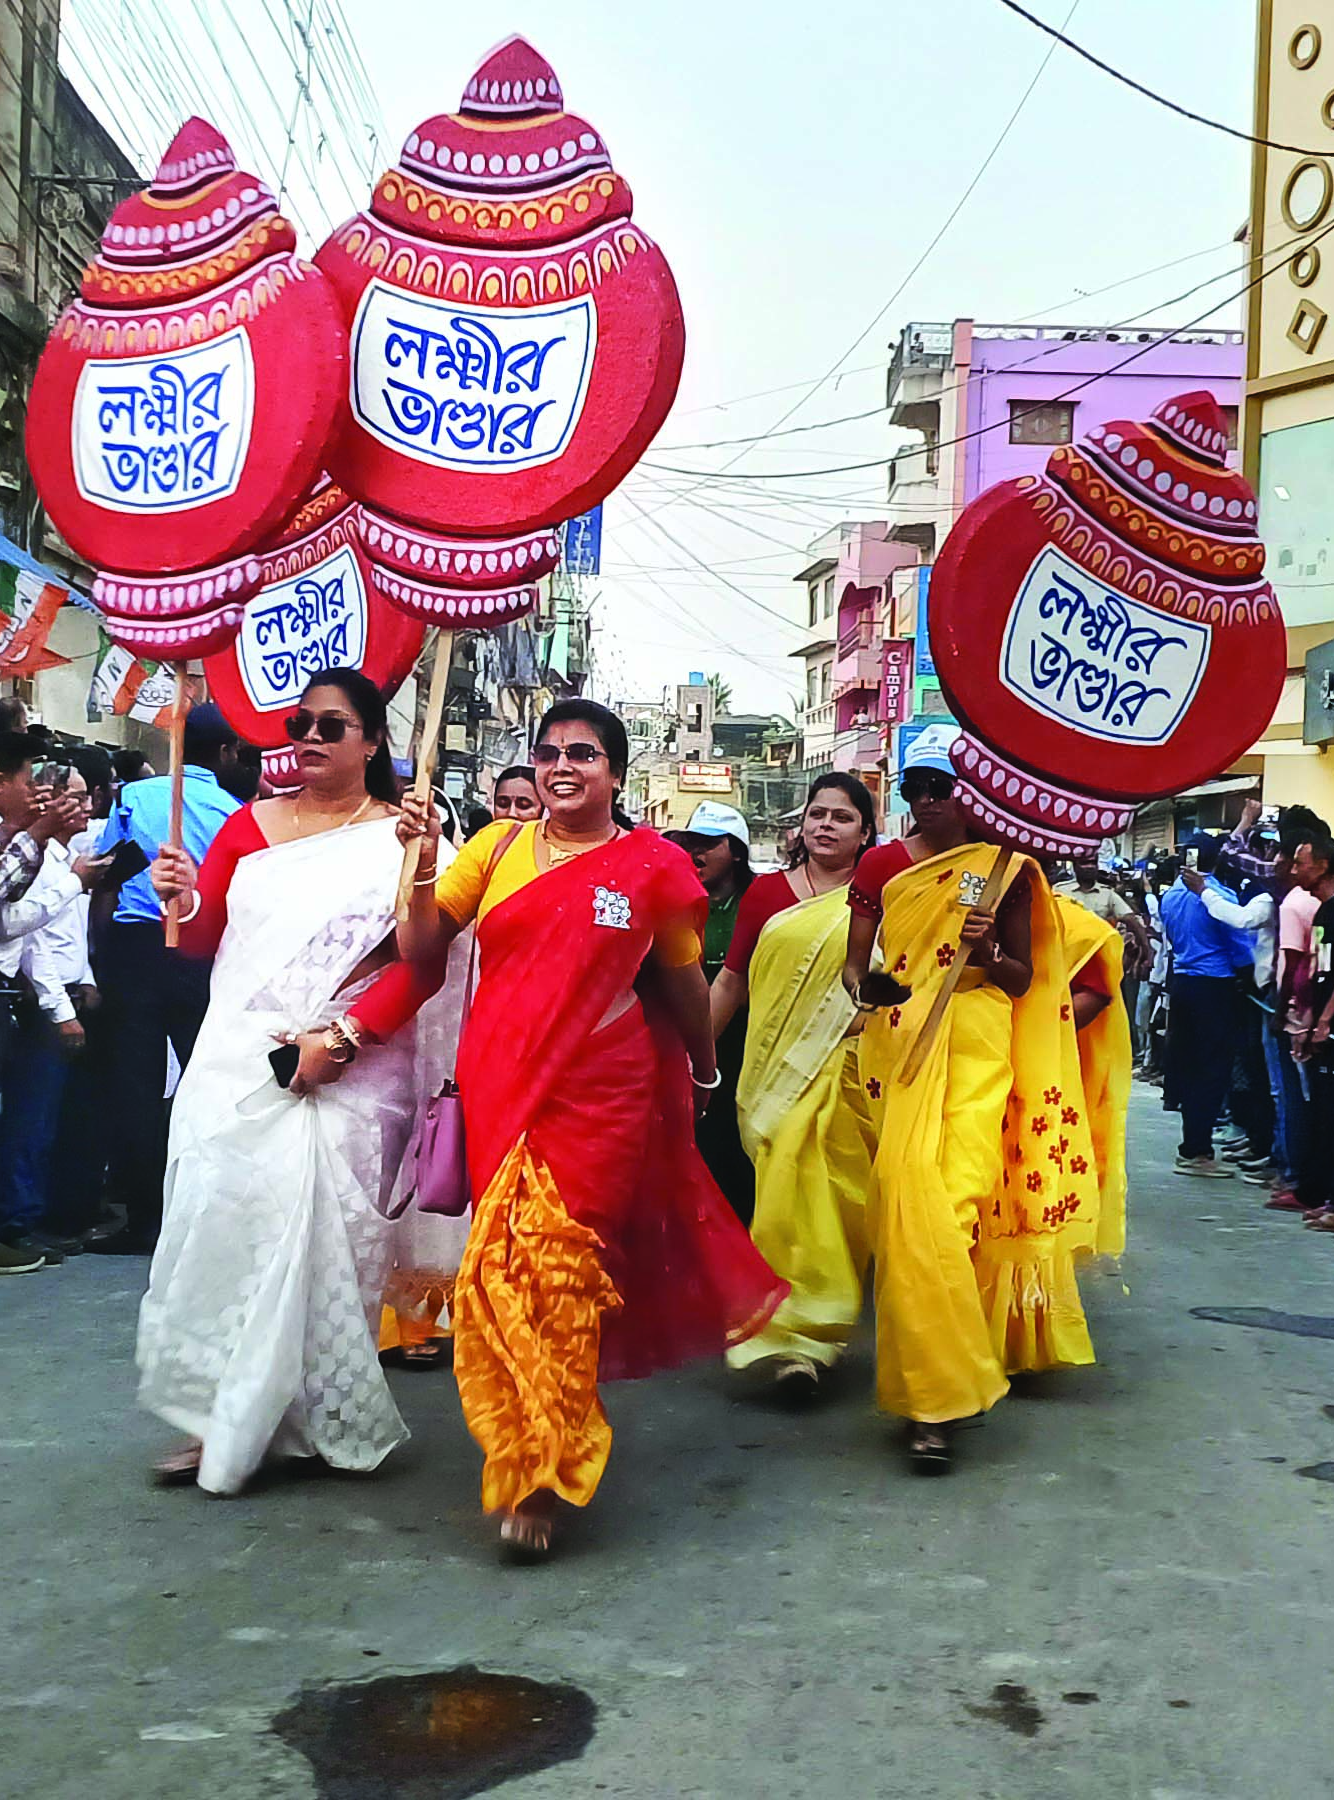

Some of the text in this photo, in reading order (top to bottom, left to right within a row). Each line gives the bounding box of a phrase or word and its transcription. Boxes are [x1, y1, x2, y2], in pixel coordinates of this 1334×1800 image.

[384, 316, 567, 394] লক্ষ্মীর
[97, 363, 231, 437] লক্ষ্মীর
[251, 569, 347, 646] লক্ষ্মীর
[1039, 570, 1188, 676] লক্ষ্মীর
[885, 651, 902, 719] Campus
